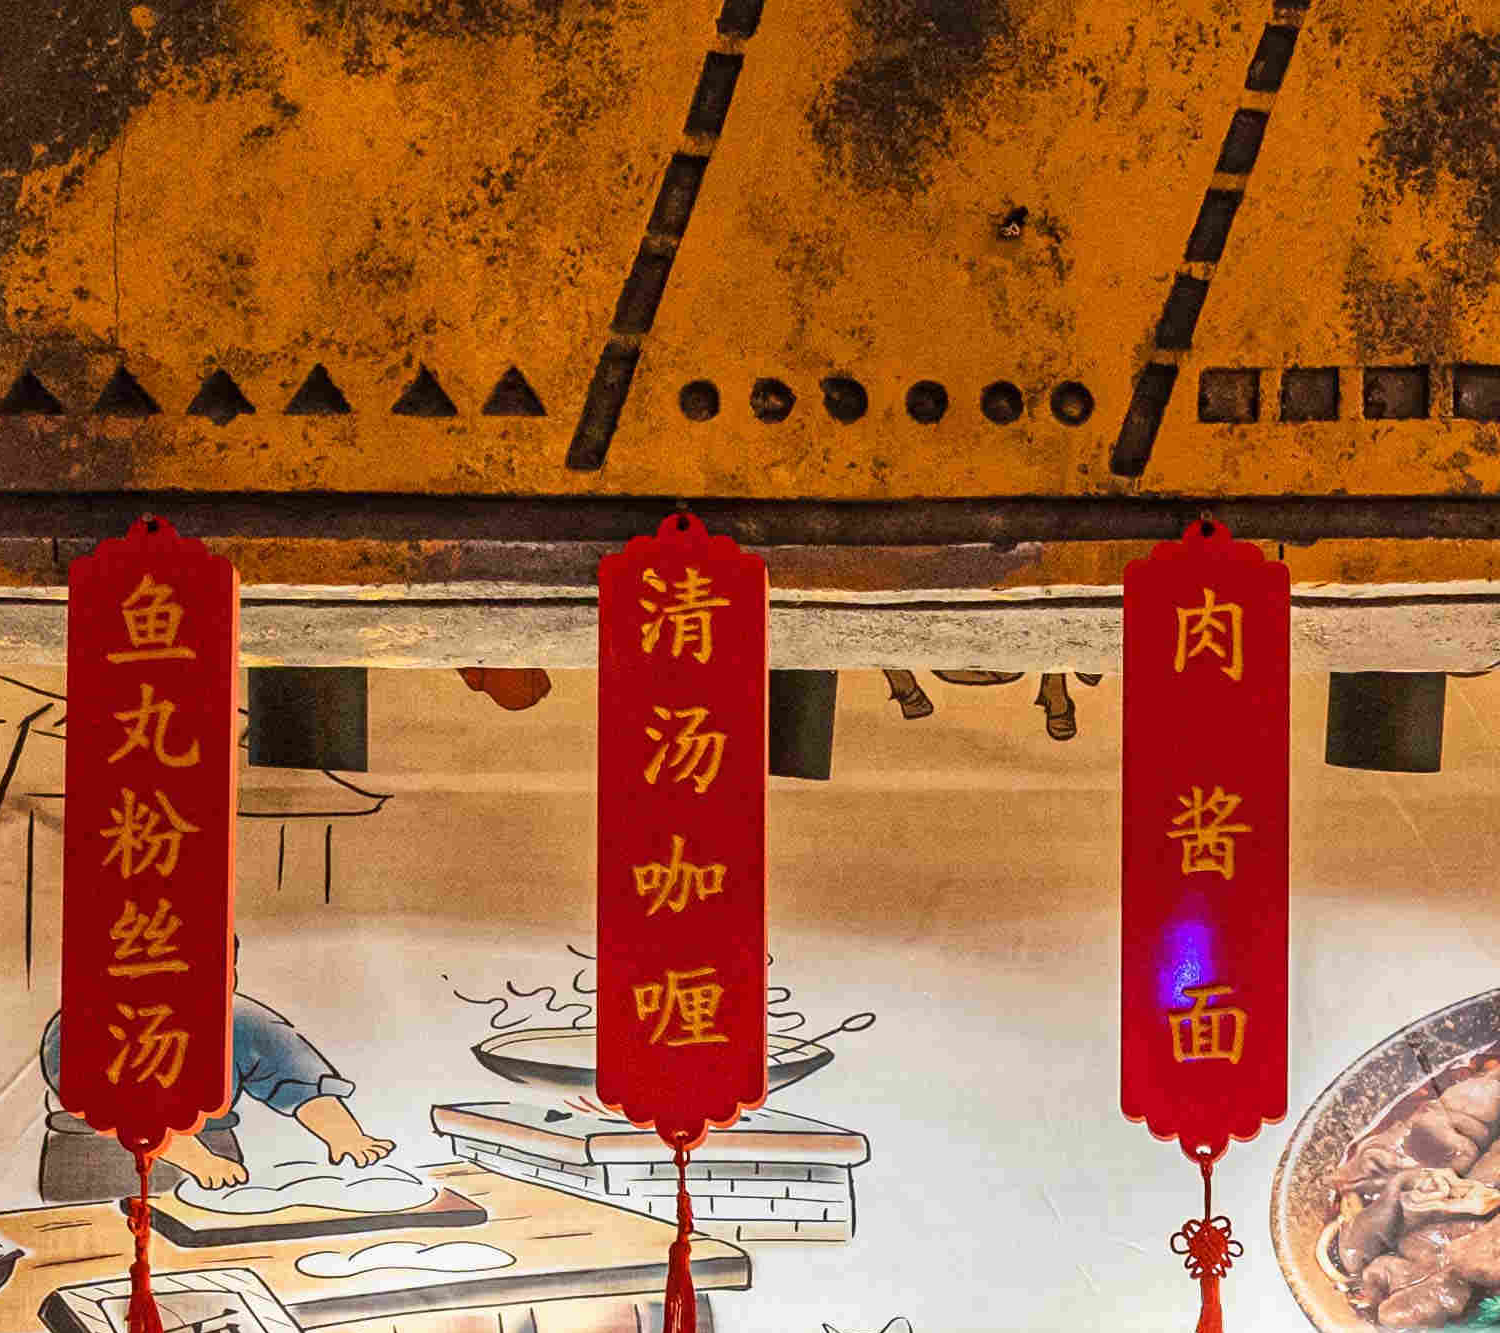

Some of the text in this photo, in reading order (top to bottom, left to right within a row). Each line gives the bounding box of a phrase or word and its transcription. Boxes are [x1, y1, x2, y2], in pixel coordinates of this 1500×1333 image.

[100, 574, 200, 1090] 鱼丸粉丝汤
[633, 567, 731, 1048] 清汤咖喱
[1166, 587, 1252, 1066] 肉酱面
